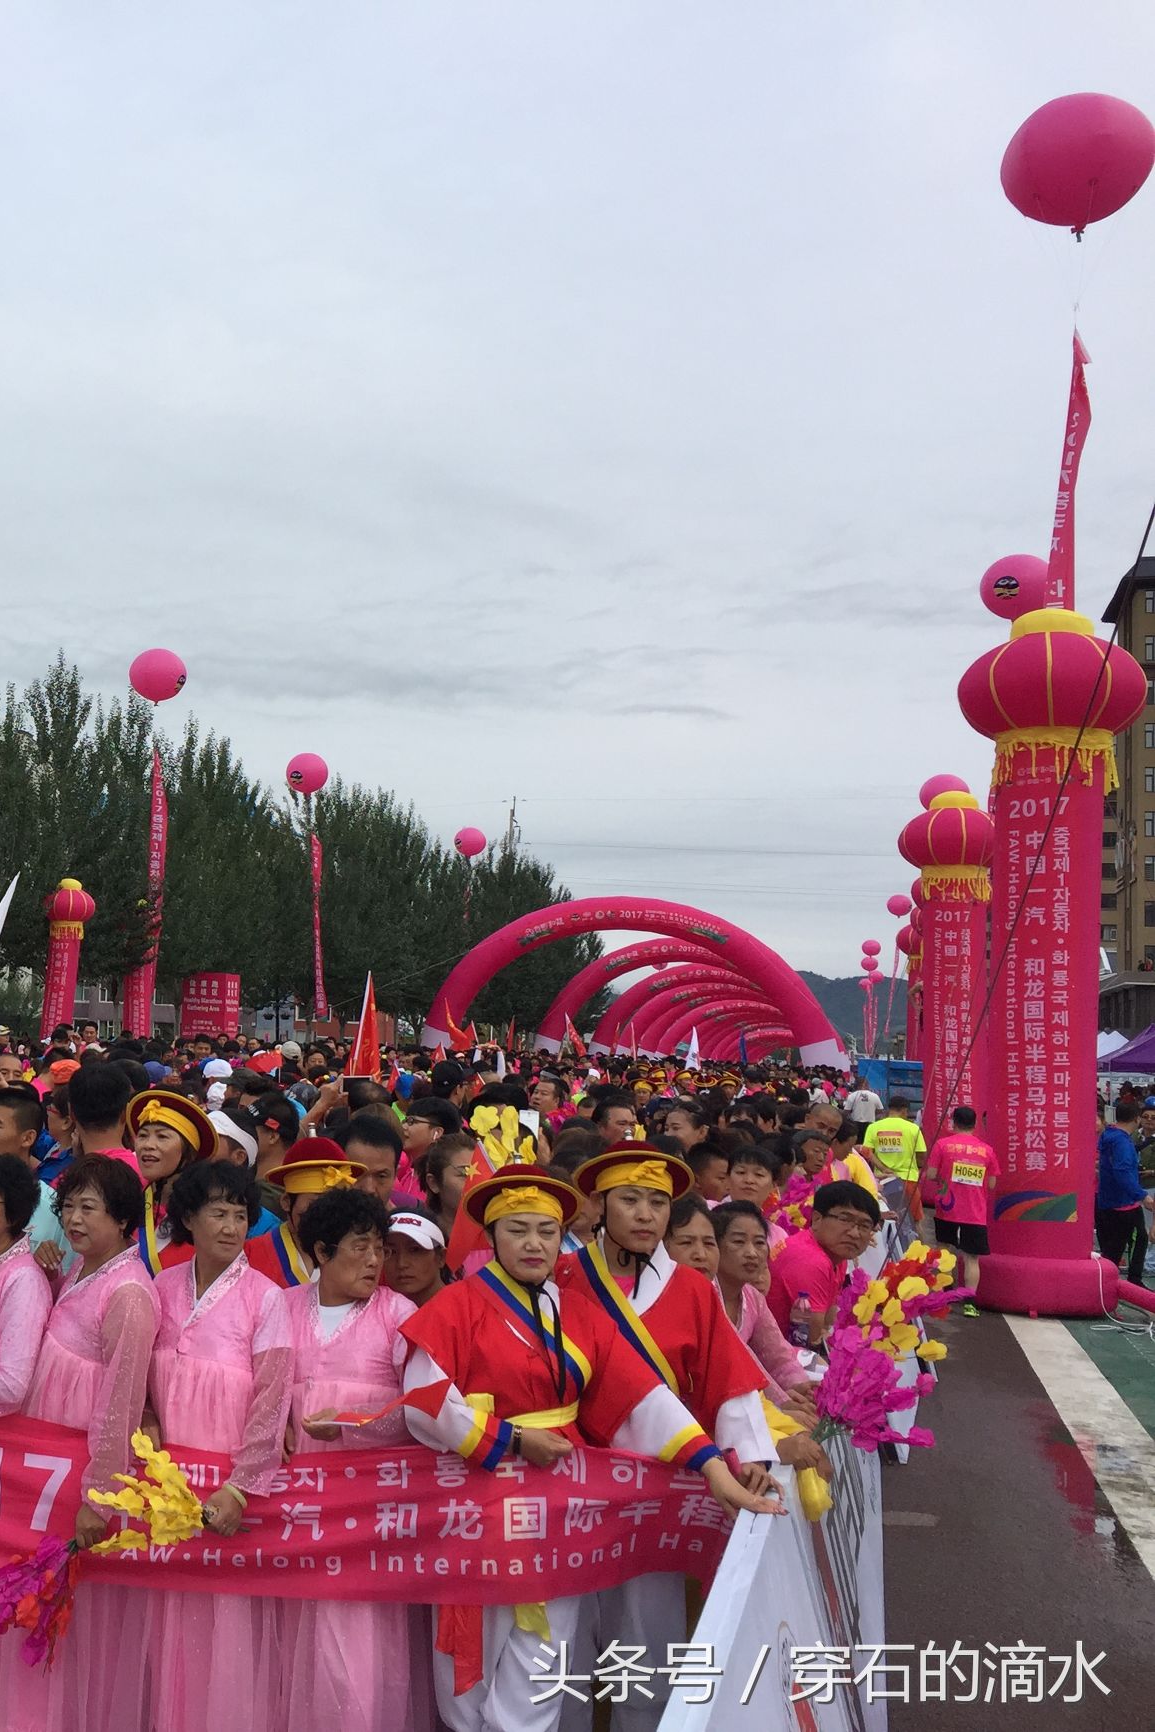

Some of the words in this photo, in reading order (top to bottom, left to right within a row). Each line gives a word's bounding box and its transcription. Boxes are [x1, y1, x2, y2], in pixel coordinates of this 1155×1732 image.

[1009, 797, 1070, 819] 2017
[619, 910, 643, 919] 2017
[934, 909, 971, 922] 2017
[1006, 937, 1019, 1046] International
[1007, 1053, 1020, 1086] Half
[1007, 1093, 1020, 1173] Marathon
[955, 1165, 983, 1179] H0645
[370, 1533, 637, 1577] International
